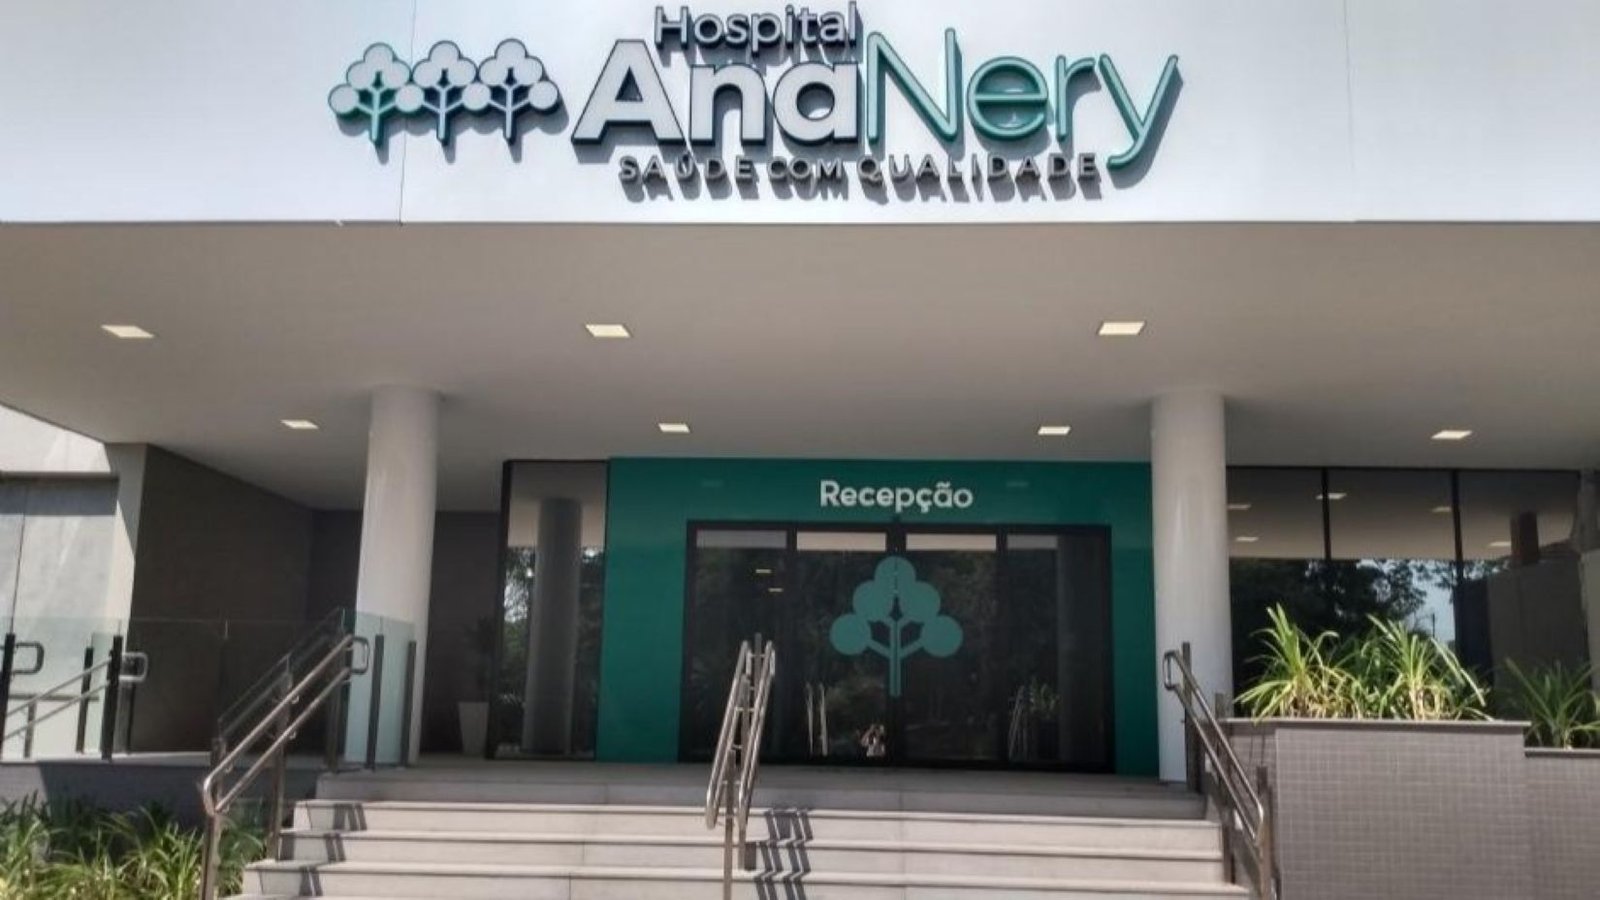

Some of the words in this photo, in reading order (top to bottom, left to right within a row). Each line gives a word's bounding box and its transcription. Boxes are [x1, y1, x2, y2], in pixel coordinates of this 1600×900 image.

[654, 1, 857, 56] Hospital
[618, 151, 754, 182] SAÚDE
[767, 156, 844, 182] COM
[856, 152, 1096, 183] QUALIDADE
[820, 479, 974, 514] Recepção
